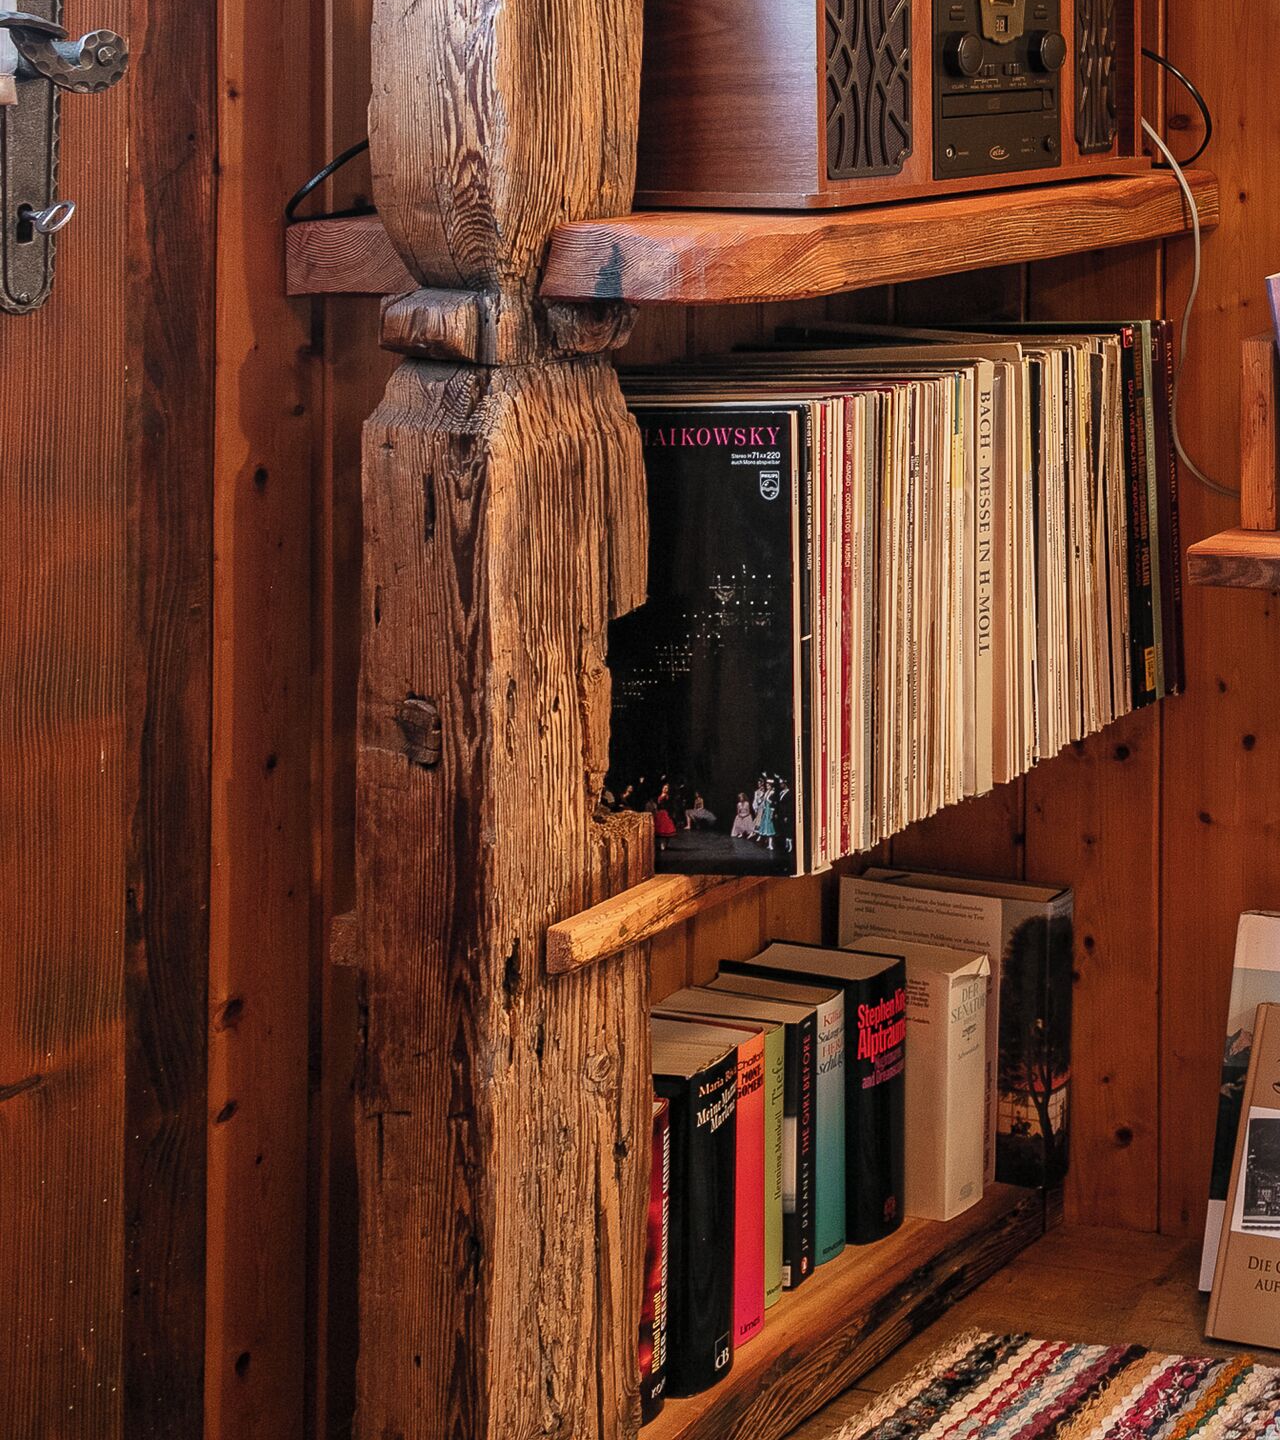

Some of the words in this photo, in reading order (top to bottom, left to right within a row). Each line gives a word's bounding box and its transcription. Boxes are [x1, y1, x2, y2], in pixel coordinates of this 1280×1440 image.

[978, 390, 993, 444] BACH
[979, 462, 993, 533] MESSE
[977, 570, 992, 658] H-MOLL
